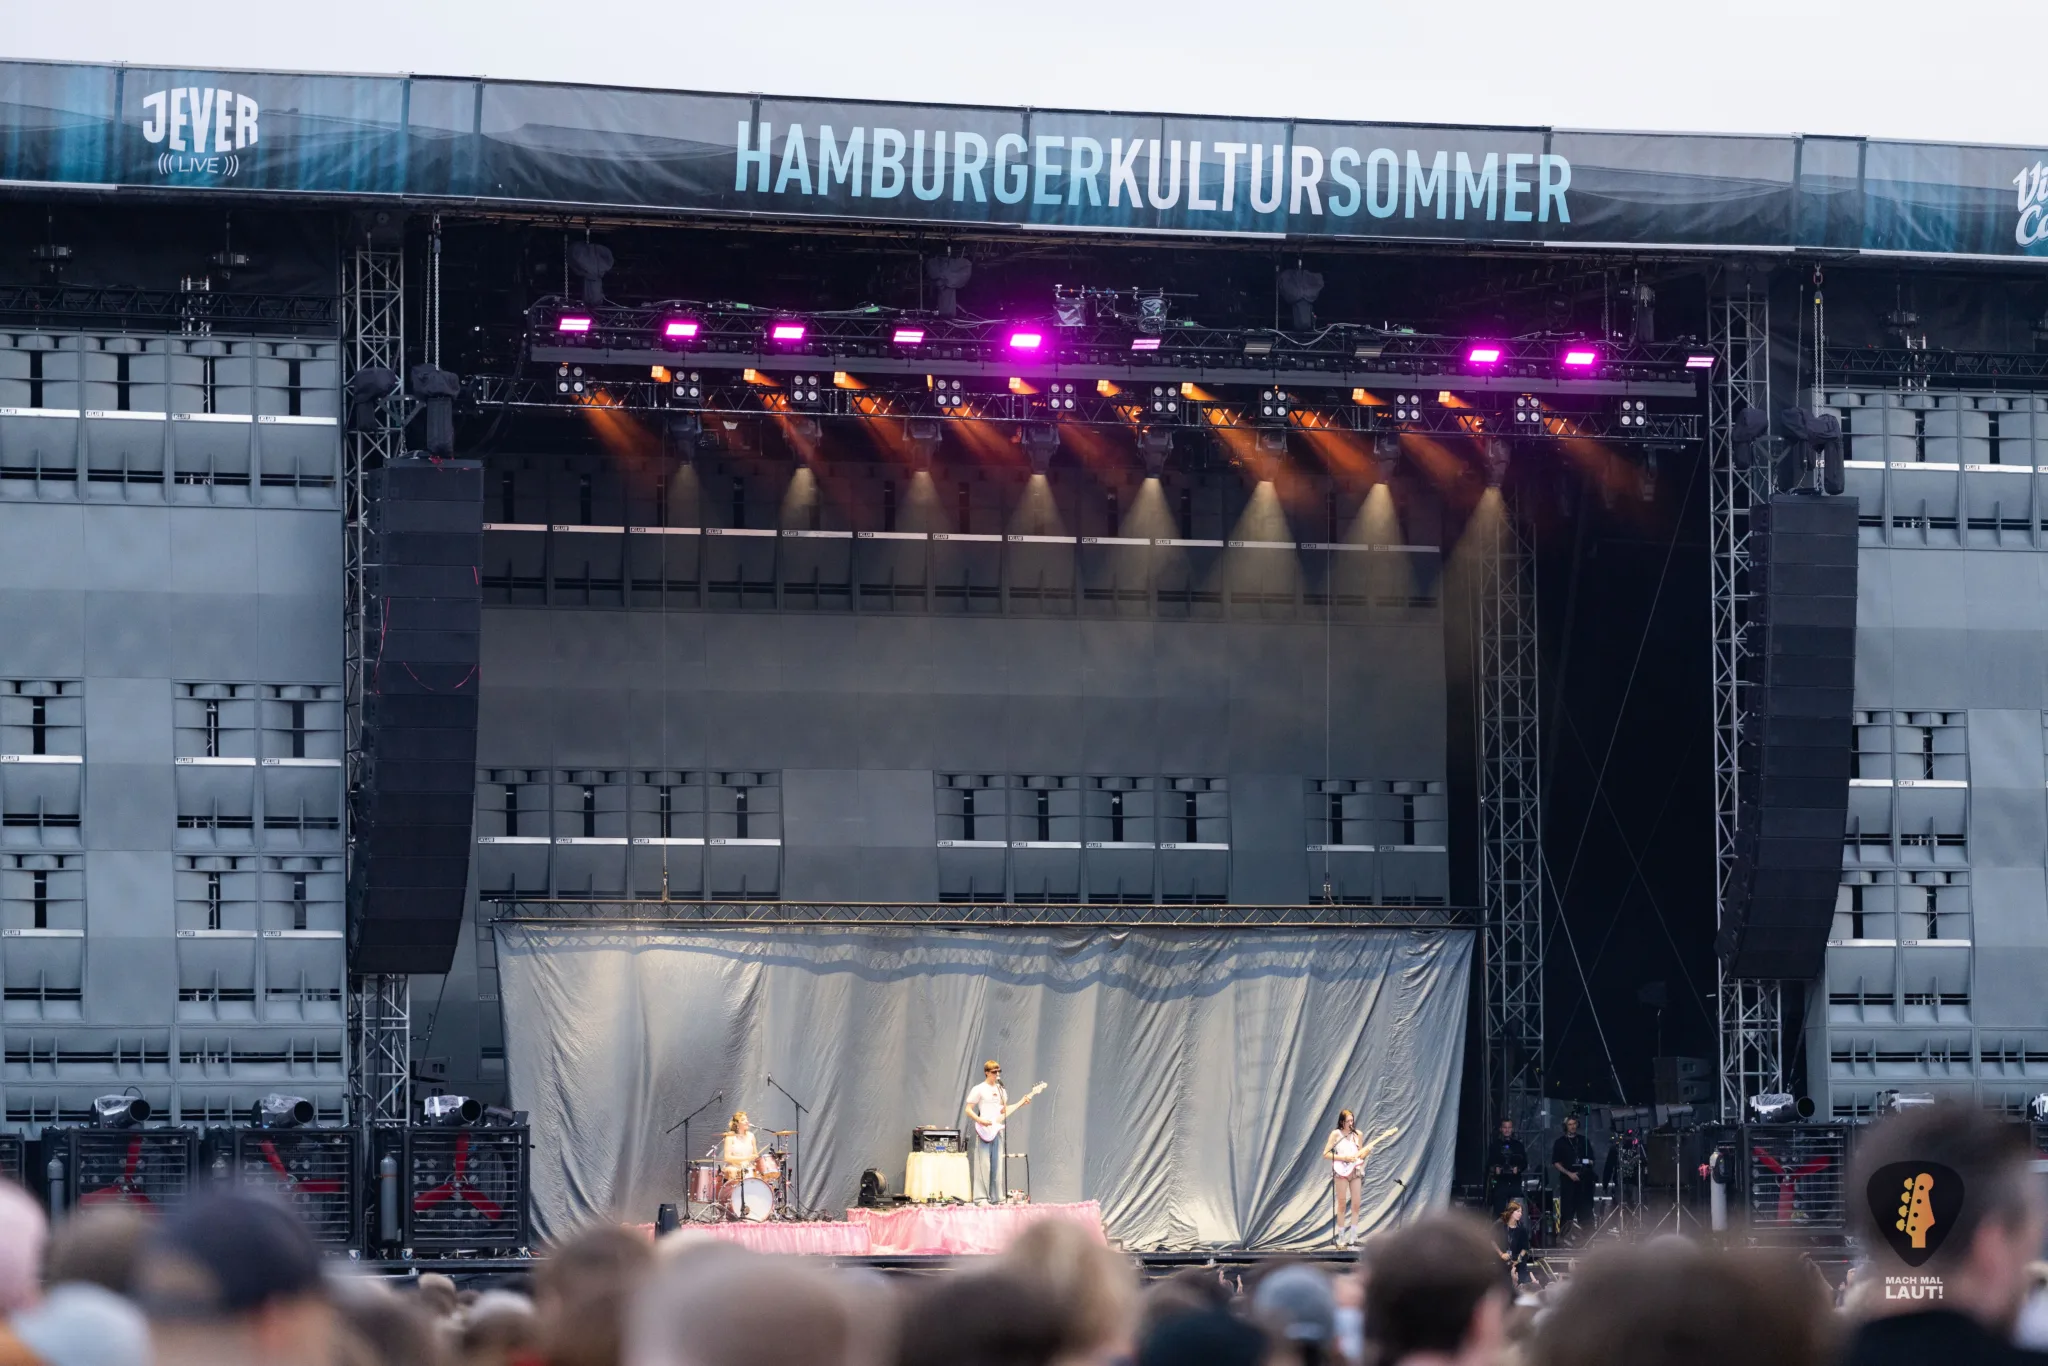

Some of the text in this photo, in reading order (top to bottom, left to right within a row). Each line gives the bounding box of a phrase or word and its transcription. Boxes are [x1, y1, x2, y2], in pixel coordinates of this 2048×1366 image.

[143, 87, 258, 153] JEVER
[178, 156, 219, 174] LIVE
[735, 121, 1571, 223] HAMBURGERKULTURSOMMER
